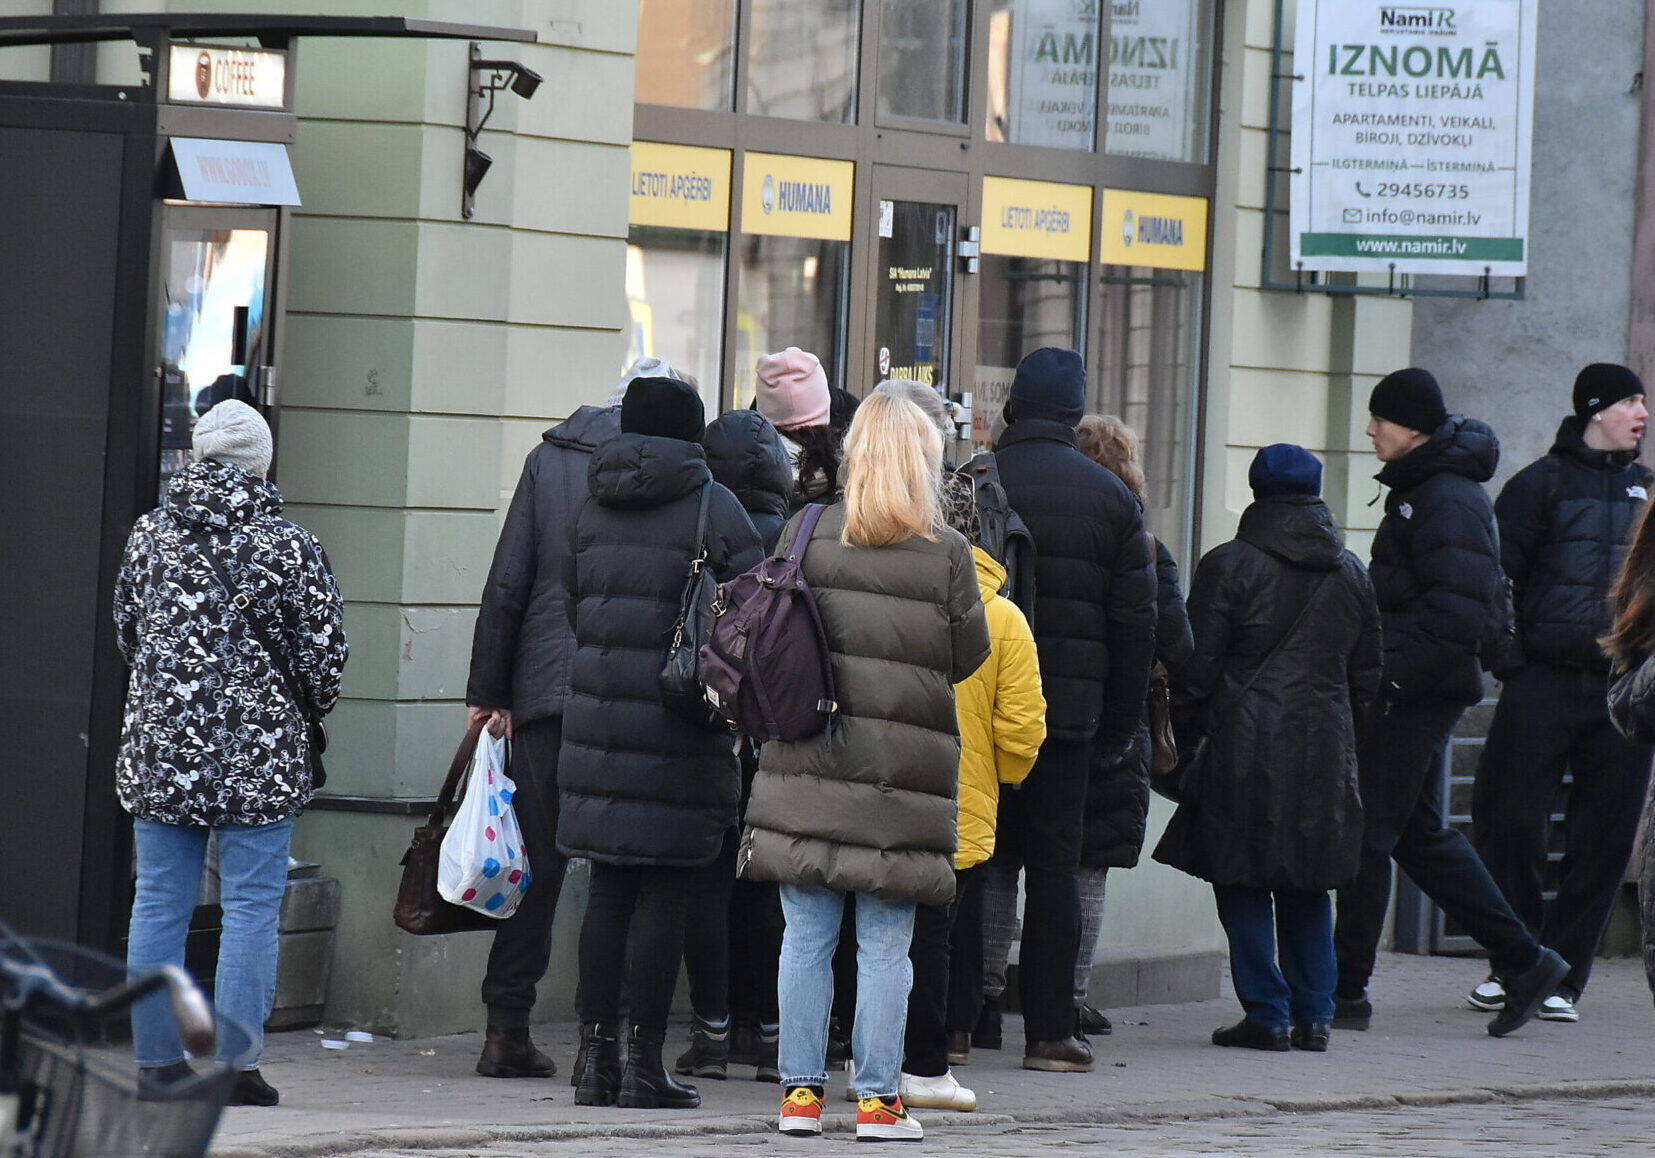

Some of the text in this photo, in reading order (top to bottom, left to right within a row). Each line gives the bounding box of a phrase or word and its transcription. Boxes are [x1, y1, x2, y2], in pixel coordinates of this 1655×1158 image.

[1328, 41, 1505, 80] IZNOMĀ
[215, 58, 256, 96] COFFEE
[1347, 83, 1484, 100] TELPAS LIEPĀJĀ
[1331, 112, 1496, 131] APARTAMENTI, VEIKALI,
[1355, 131, 1473, 148] BIROJI, DZĪVOKĻI
[631, 171, 668, 199] LIETOTI
[1376, 182, 1470, 199] 29456735
[778, 180, 832, 215] HUMANA
[1001, 205, 1033, 230] LIETOTI
[1366, 208, 1481, 226] info@namir.lv
[1137, 214, 1184, 247] HUMANA
[1355, 238, 1467, 255] www.namir.lv
